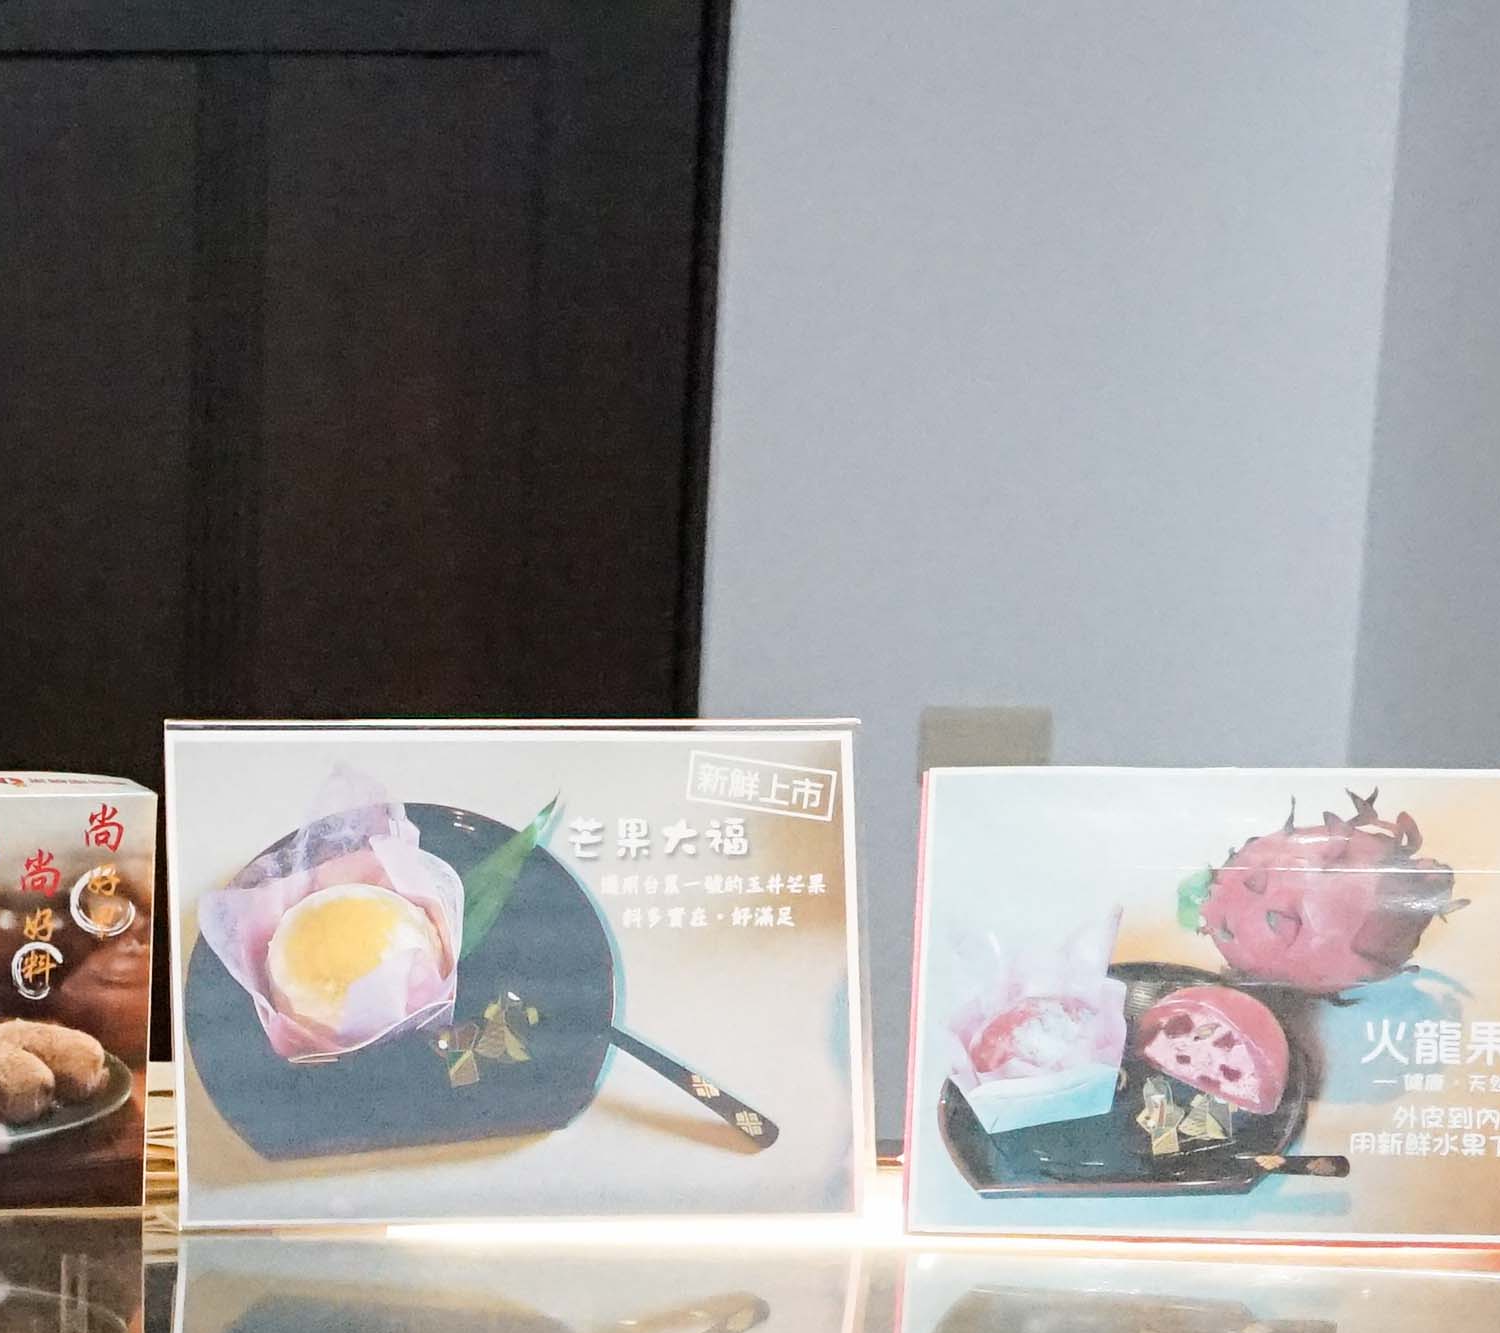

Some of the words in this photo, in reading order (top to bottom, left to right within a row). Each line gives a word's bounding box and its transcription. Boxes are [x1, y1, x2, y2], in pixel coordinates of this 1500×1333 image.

[697, 763, 825, 810] 新鮮上市
[568, 816, 749, 860] 芒果大福
